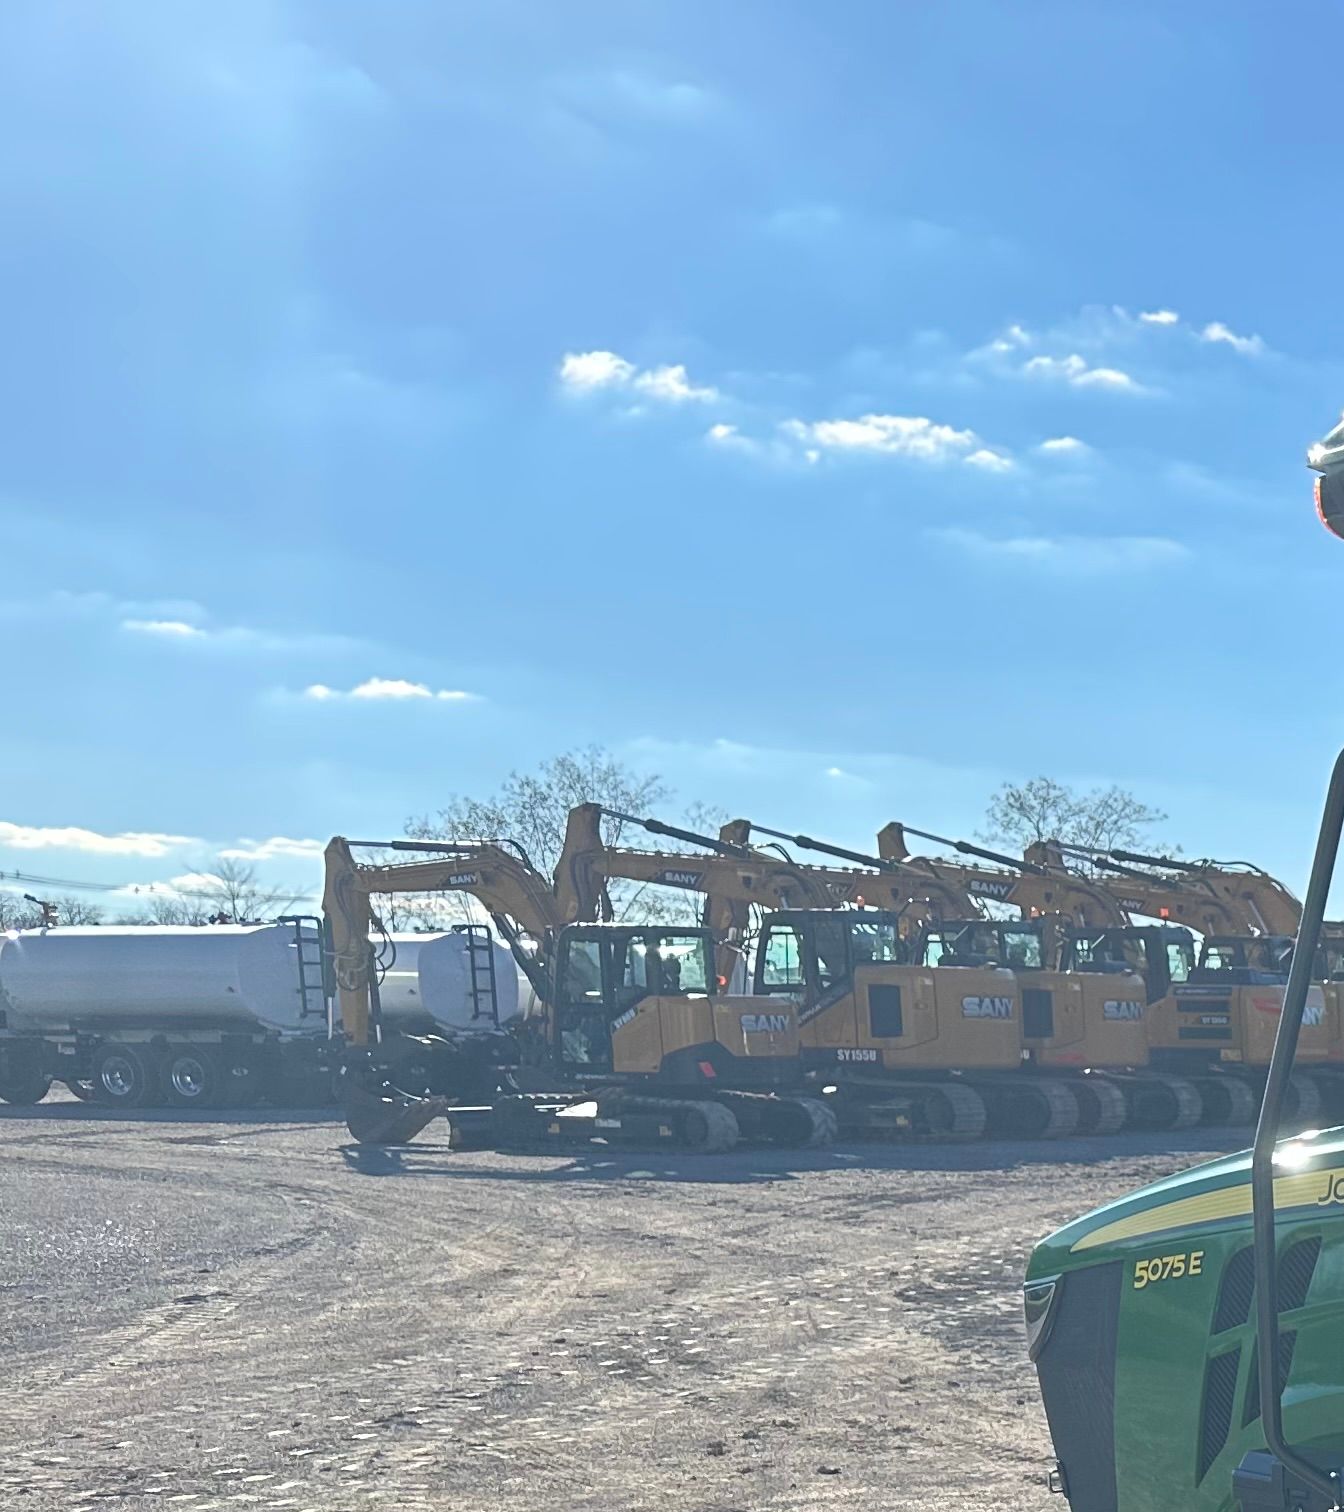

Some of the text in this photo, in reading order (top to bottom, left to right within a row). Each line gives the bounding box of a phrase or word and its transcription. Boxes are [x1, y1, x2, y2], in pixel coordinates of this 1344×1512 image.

[449, 873, 478, 885] SANY
[664, 871, 698, 886] SANY
[970, 879, 1010, 896] SANY
[962, 996, 1014, 1018] SANY
[740, 1013, 790, 1034] SANY
[836, 1049, 877, 1062] SY155U
